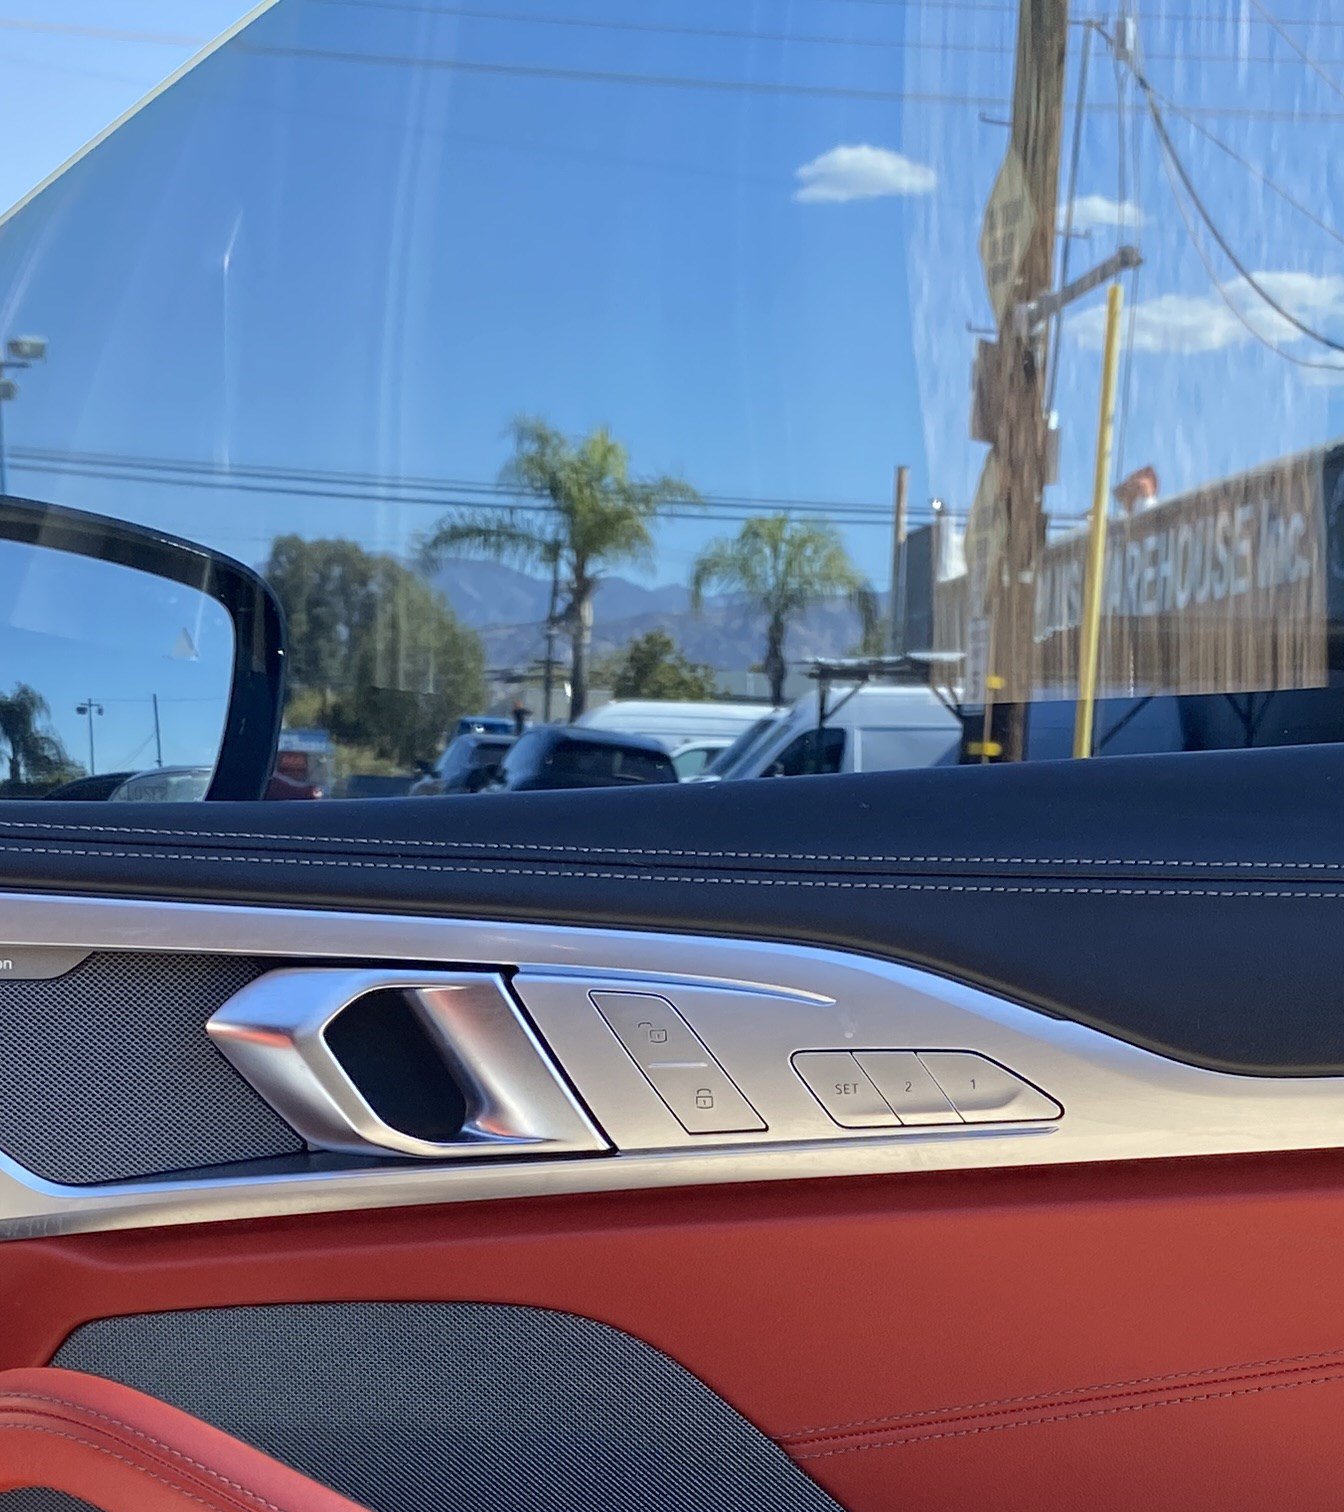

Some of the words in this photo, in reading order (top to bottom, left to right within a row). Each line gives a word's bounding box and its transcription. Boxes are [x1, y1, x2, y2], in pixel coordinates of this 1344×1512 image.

[1096, 504, 1255, 616] AREHOUSE
[835, 1083, 858, 1095] SET
[905, 1081, 912, 1092] 2
[970, 1079, 976, 1090] 1
